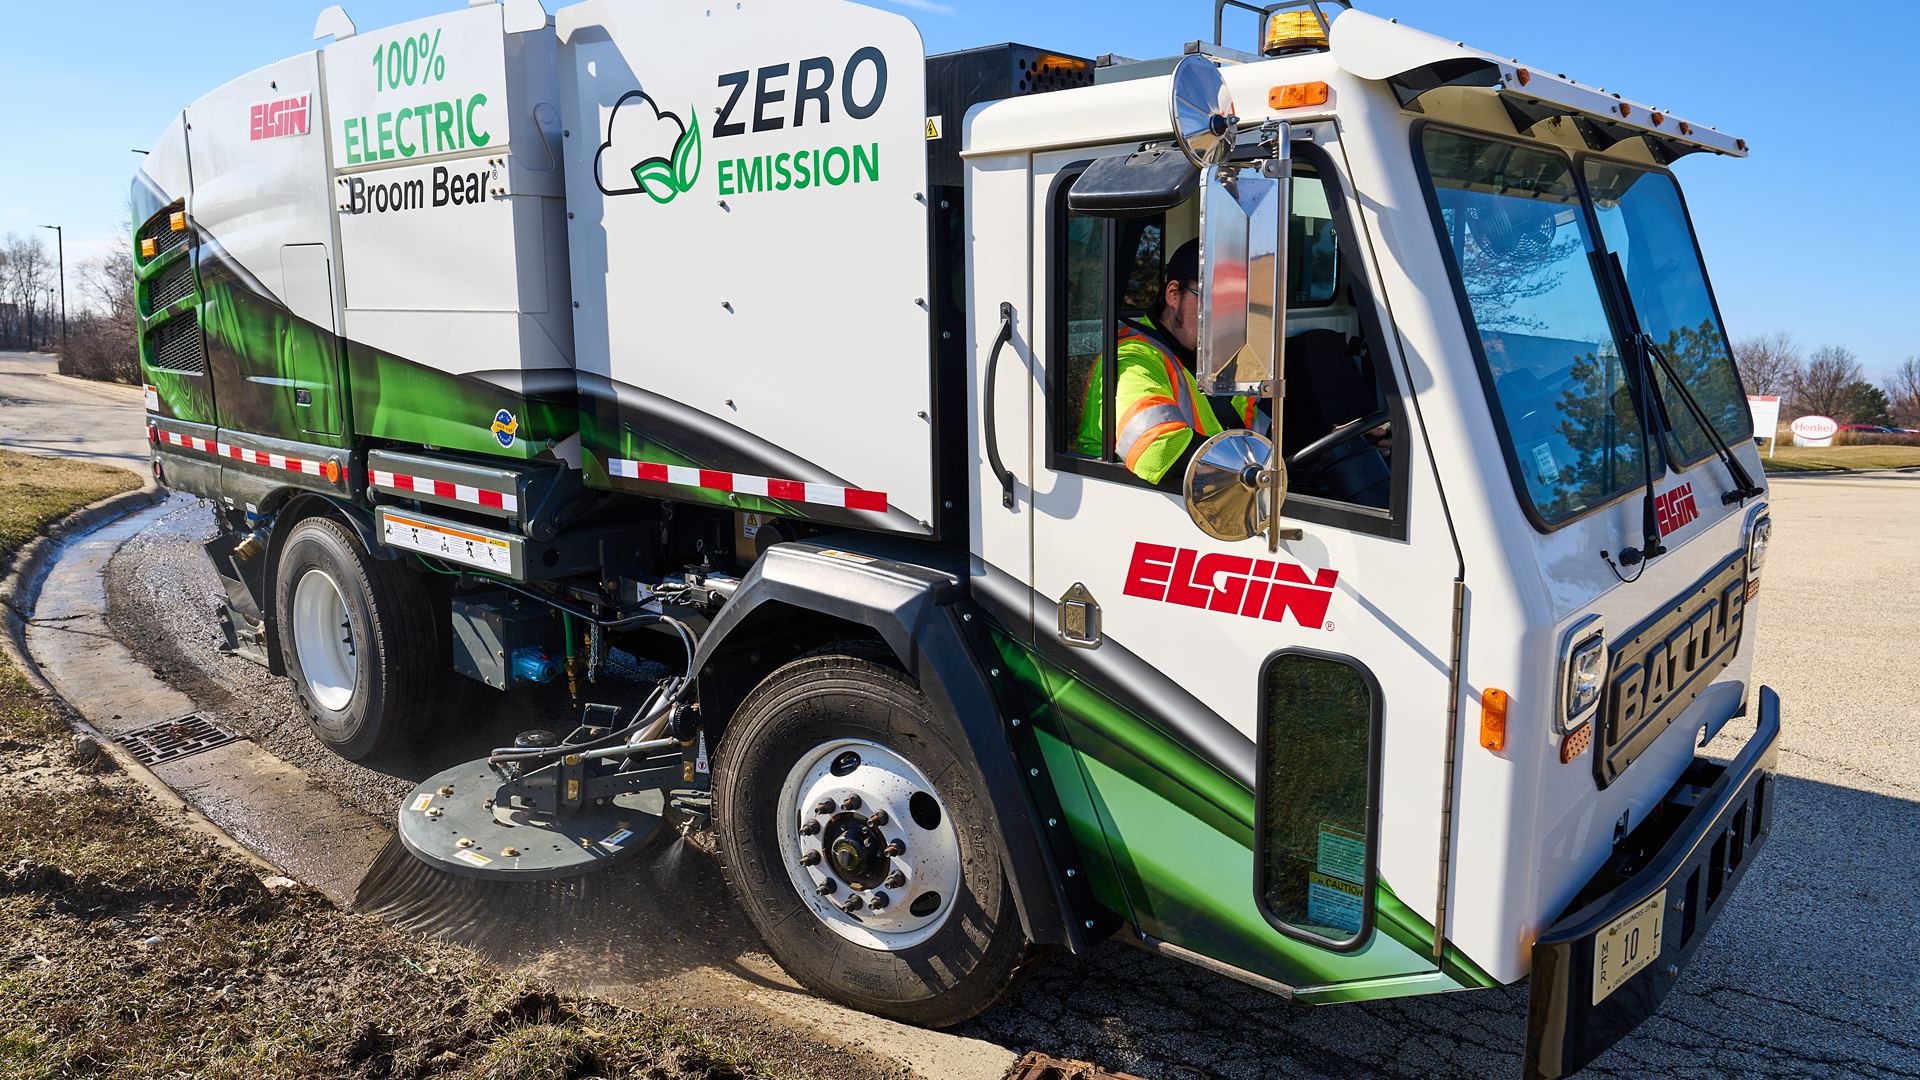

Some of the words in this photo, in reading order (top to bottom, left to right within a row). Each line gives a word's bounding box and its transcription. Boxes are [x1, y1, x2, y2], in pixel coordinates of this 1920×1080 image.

[372, 28, 446, 92] 100%
[713, 46, 888, 138] ZERO
[250, 96, 307, 141] ELGIN
[344, 93, 491, 165] ELECTRIC
[718, 142, 880, 195] EMISSION
[351, 177, 424, 215] Broom
[1794, 422, 1834, 433] Henkel
[1655, 482, 1698, 537] ELGIN
[1122, 541, 1340, 630] ELGIN
[1609, 578, 1745, 747] BATTLE
[1325, 878, 1364, 897] CAUTION
[1623, 909, 1644, 927] ILLINOIS
[1653, 916, 1660, 939] L
[1621, 926, 1640, 968] 10
